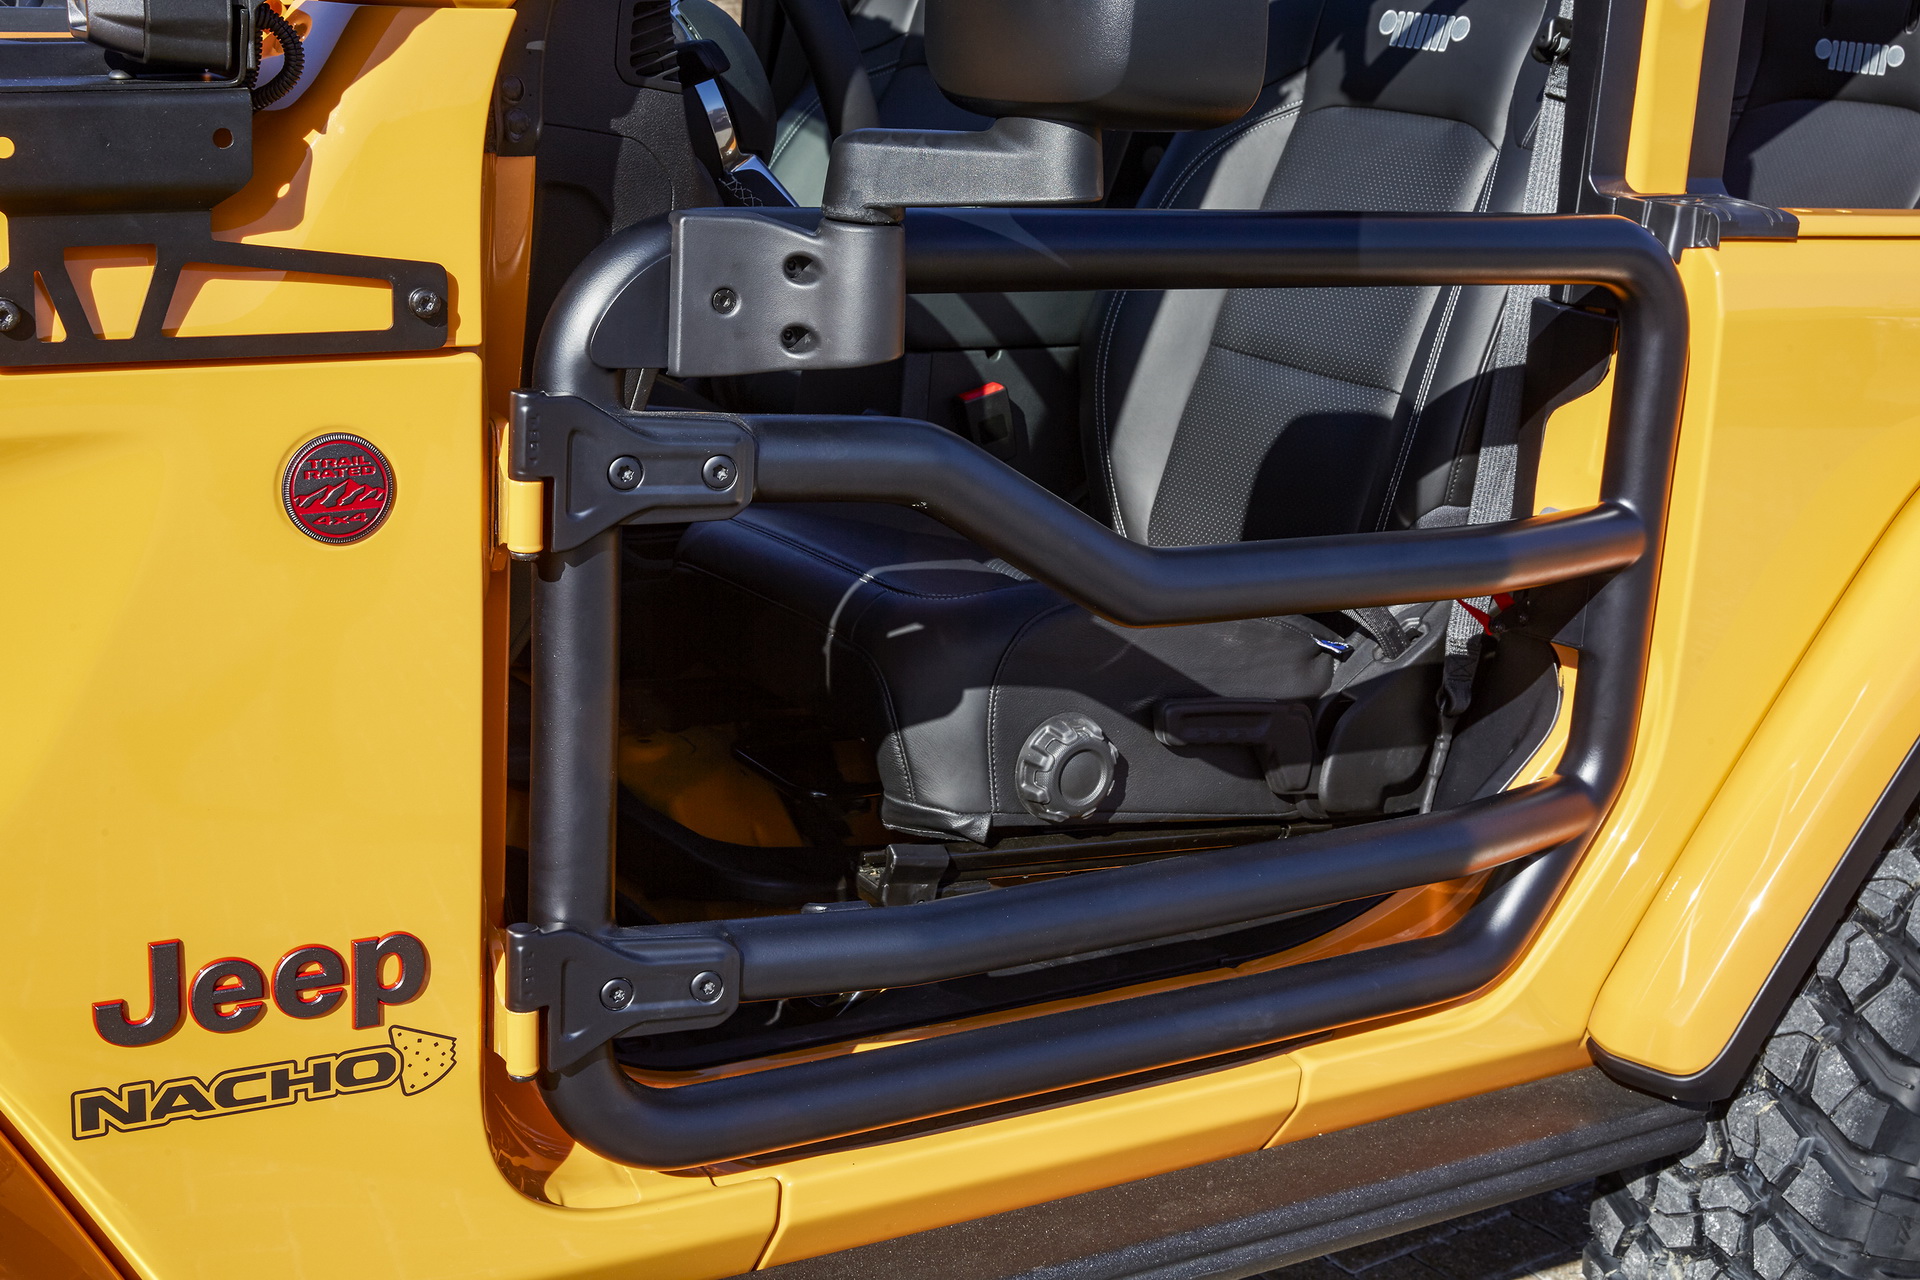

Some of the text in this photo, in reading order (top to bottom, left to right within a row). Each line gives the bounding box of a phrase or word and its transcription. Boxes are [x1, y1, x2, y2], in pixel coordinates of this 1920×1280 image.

[307, 455, 372, 470] TRAIL
[303, 465, 377, 480] RATED
[312, 512, 368, 526] 4x4
[92, 930, 429, 1047] Jeep
[78, 1049, 398, 1134] NACHO
